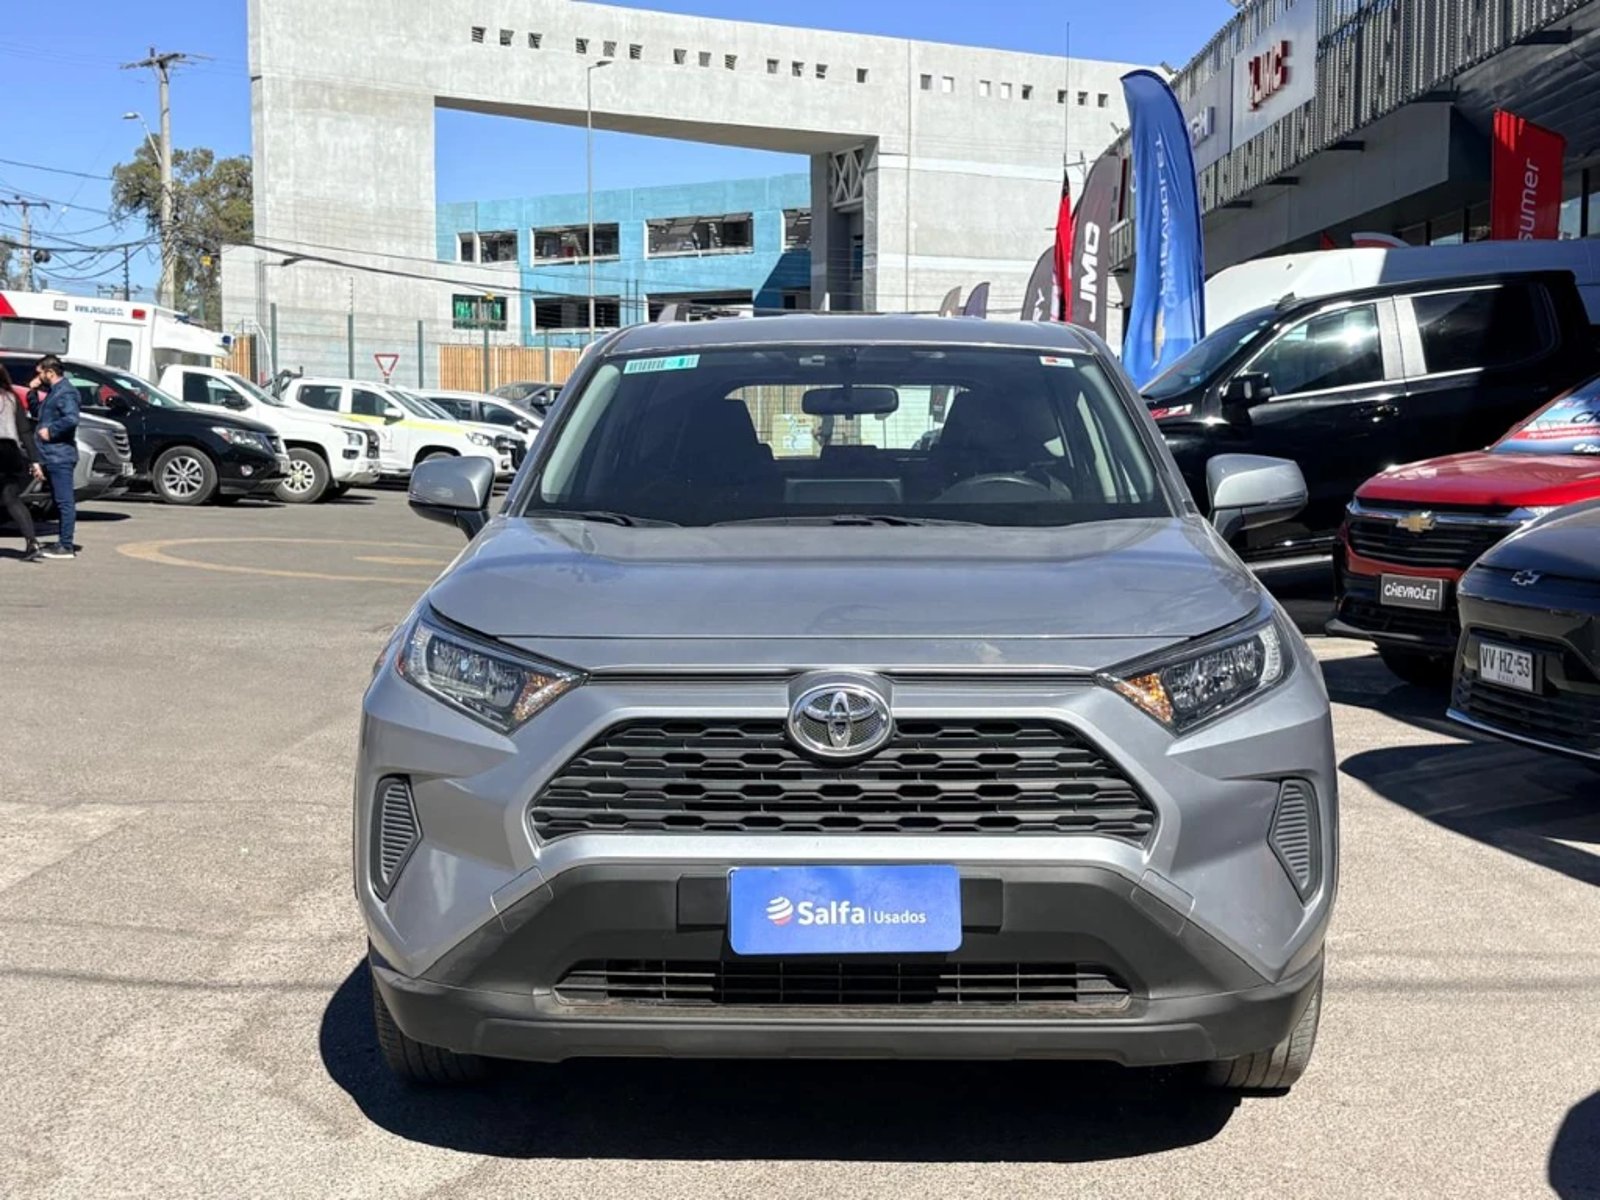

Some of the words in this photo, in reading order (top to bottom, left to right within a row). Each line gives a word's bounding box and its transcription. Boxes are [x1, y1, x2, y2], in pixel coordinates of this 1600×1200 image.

[1080, 221, 1100, 322] JMC
[1384, 581, 1437, 601] CHEVROLET
[797, 901, 865, 925] Salfa
[873, 910, 926, 924] Usados
